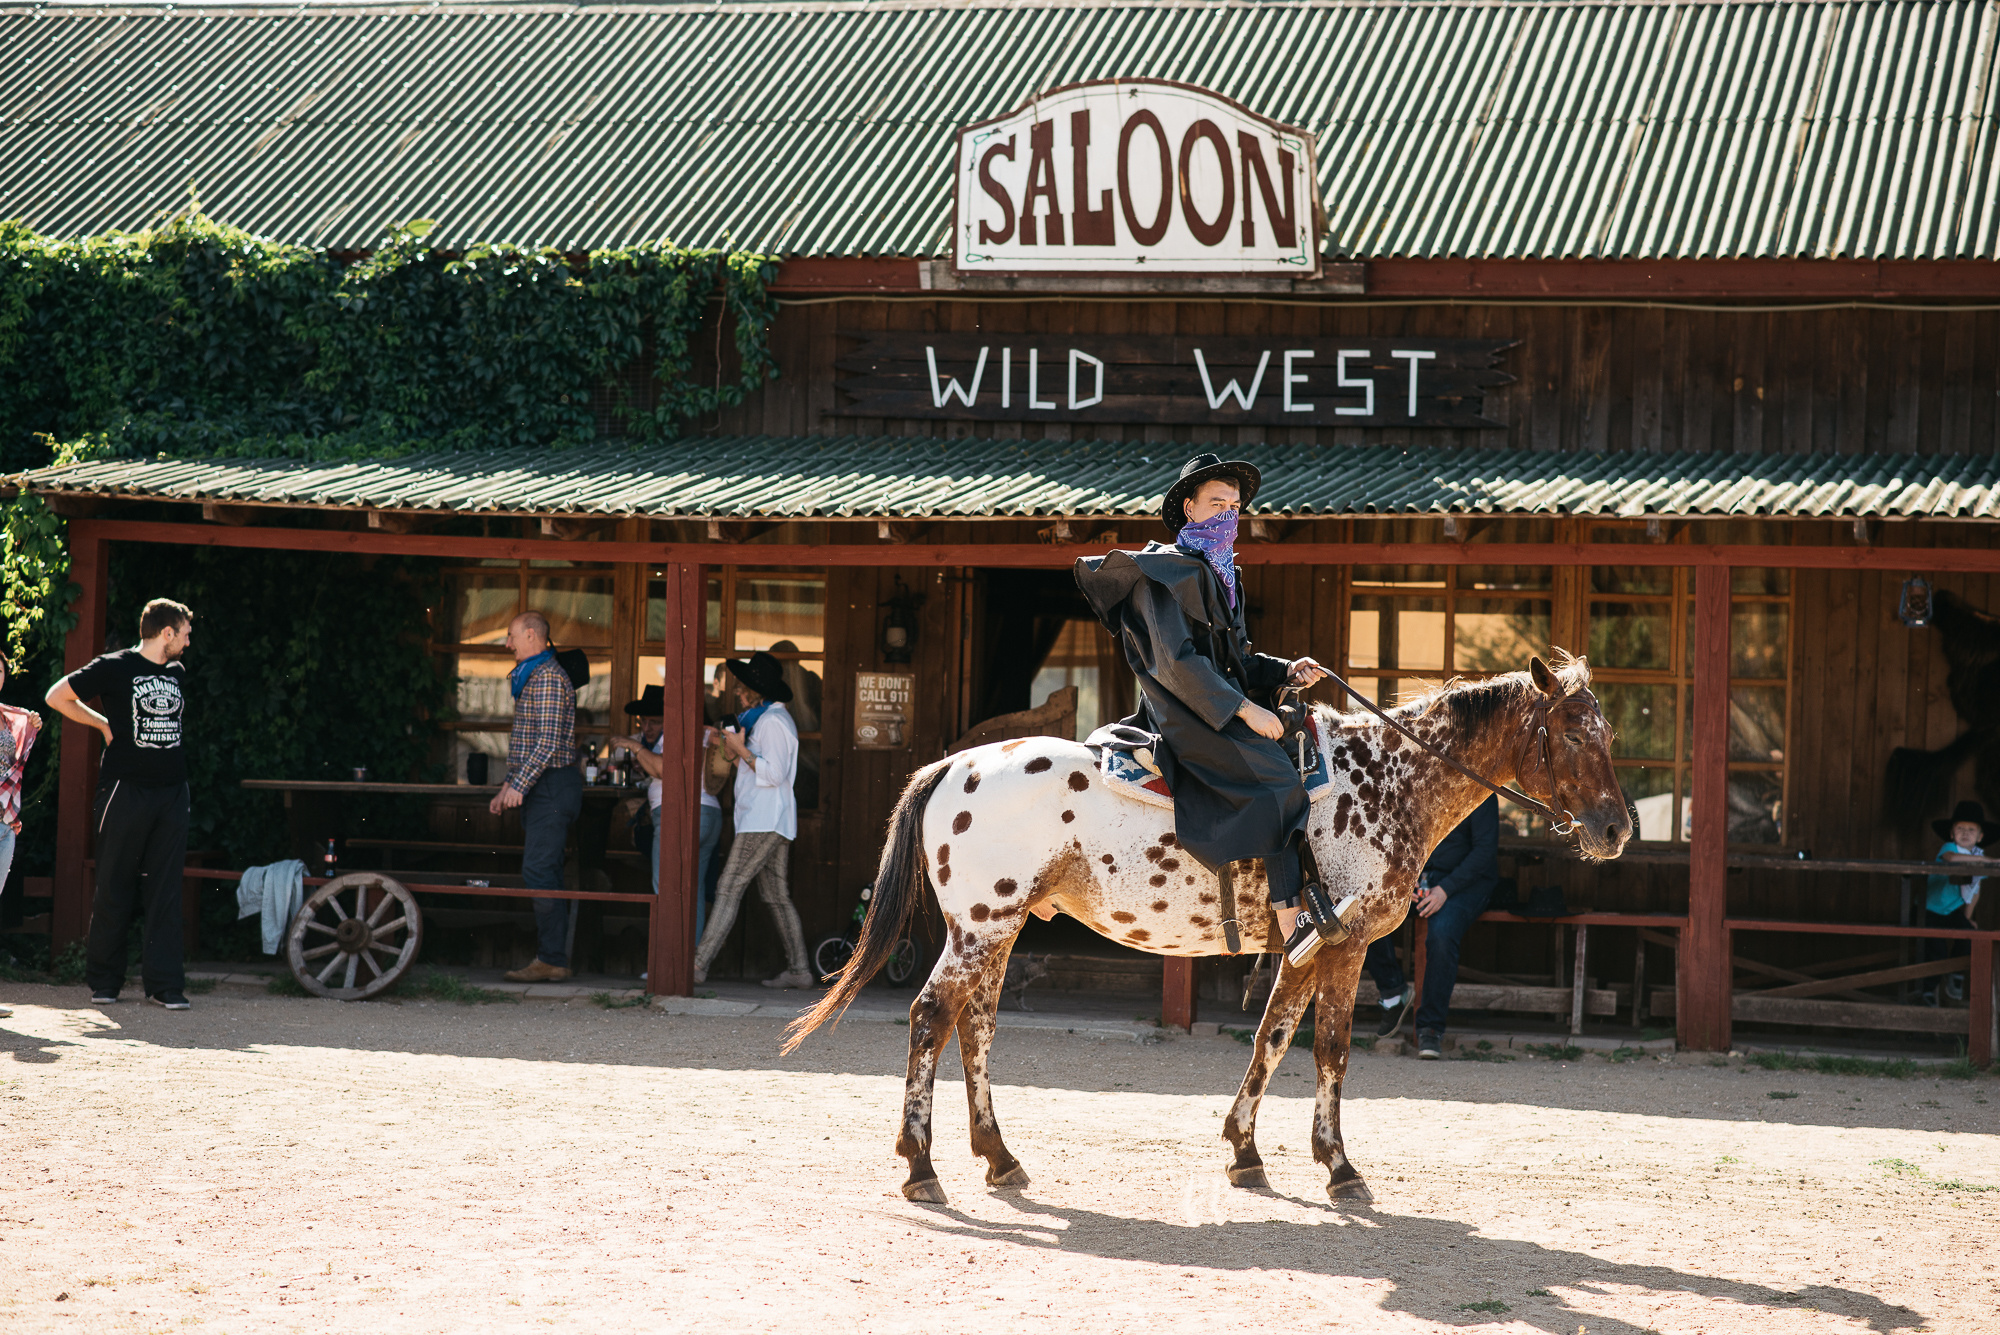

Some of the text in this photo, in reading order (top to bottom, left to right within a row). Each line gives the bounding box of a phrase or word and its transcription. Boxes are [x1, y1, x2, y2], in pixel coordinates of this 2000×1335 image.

[978, 108, 1297, 248] SALOON
[925, 345, 1436, 417] WILD WEST
[133, 682, 155, 698] JACK
[859, 676, 910, 690] WE DON'T
[860, 690, 909, 703] CALL 911
